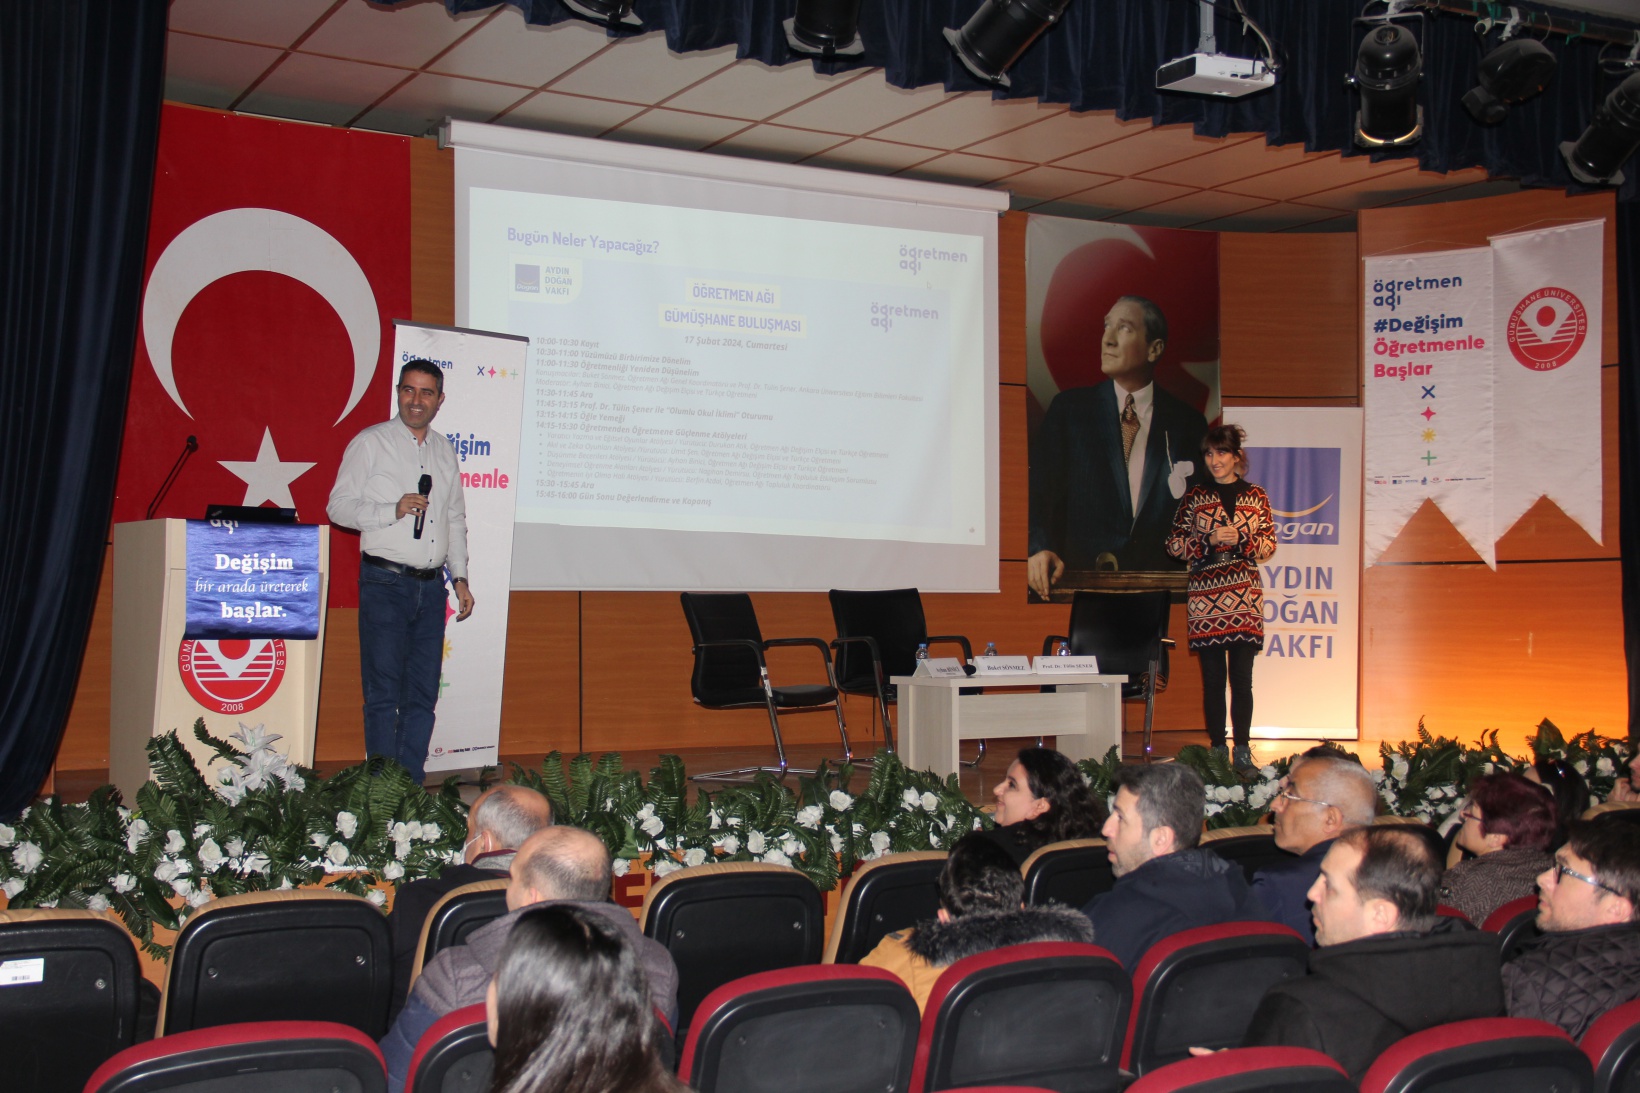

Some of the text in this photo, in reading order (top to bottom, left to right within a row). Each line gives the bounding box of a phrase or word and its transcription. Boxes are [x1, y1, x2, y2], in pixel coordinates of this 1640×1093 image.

[507, 227, 660, 256] Bugün Neler Yapacağız?
[544, 275, 573, 286] DOĞAN
[545, 266, 570, 276] AYDIN
[544, 286, 570, 296] VAKFI
[692, 282, 775, 304] ÖĞRETMEN AĞI
[664, 308, 801, 333] GÜMÜŞHANE BULUŞMASI
[1373, 313, 1463, 334] #Değişim
[536, 336, 600, 350] 10:00-10:30 Kayıt
[684, 335, 788, 351] 17 Şubat 2024, Cumartesi
[1373, 334, 1485, 358] Öğretmenle
[535, 347, 692, 366] 10:30-11:00 Yüzümüzü Birbirimize Dönelim
[1534, 361, 1557, 369] 2008
[535, 358, 700, 377] 11:00-11:30 Öğretmenliği Yeniden Düşünelim
[1373, 361, 1433, 381] Başlar
[535, 388, 594, 399] 11:30-11:45 Ara
[535, 399, 579, 409] 11:45-13:15
[579, 401, 598, 412] Prof.
[599, 402, 610, 411] Dr.
[612, 403, 631, 412] Tülin
[631, 404, 654, 415] Şener
[654, 405, 665, 414] ile
[696, 408, 715, 417] Okul
[741, 411, 774, 421] Oturumu
[535, 410, 626, 425] 13:15-14:15 Öğle Yemeği
[535, 420, 748, 441] 14:15-15:30 Öğretmenden Öğretmene Güçlenme Atölyeleri
[460, 467, 509, 489] menle
[580, 481, 595, 490] Ara
[535, 489, 578, 500] 15:45-16:00
[578, 492, 595, 500] Gün
[596, 492, 615, 501] Sonu
[616, 493, 671, 504] Değerlendirme
[681, 497, 712, 508] Kapanış
[215, 553, 294, 575] Değişim
[195, 577, 309, 593] bir arada üreterek
[1260, 566, 1333, 590] YDIN
[220, 601, 287, 623] başlar.
[1263, 594, 1338, 625] OĞAN
[1264, 634, 1333, 659] AKFI
[220, 702, 244, 712] 2008
